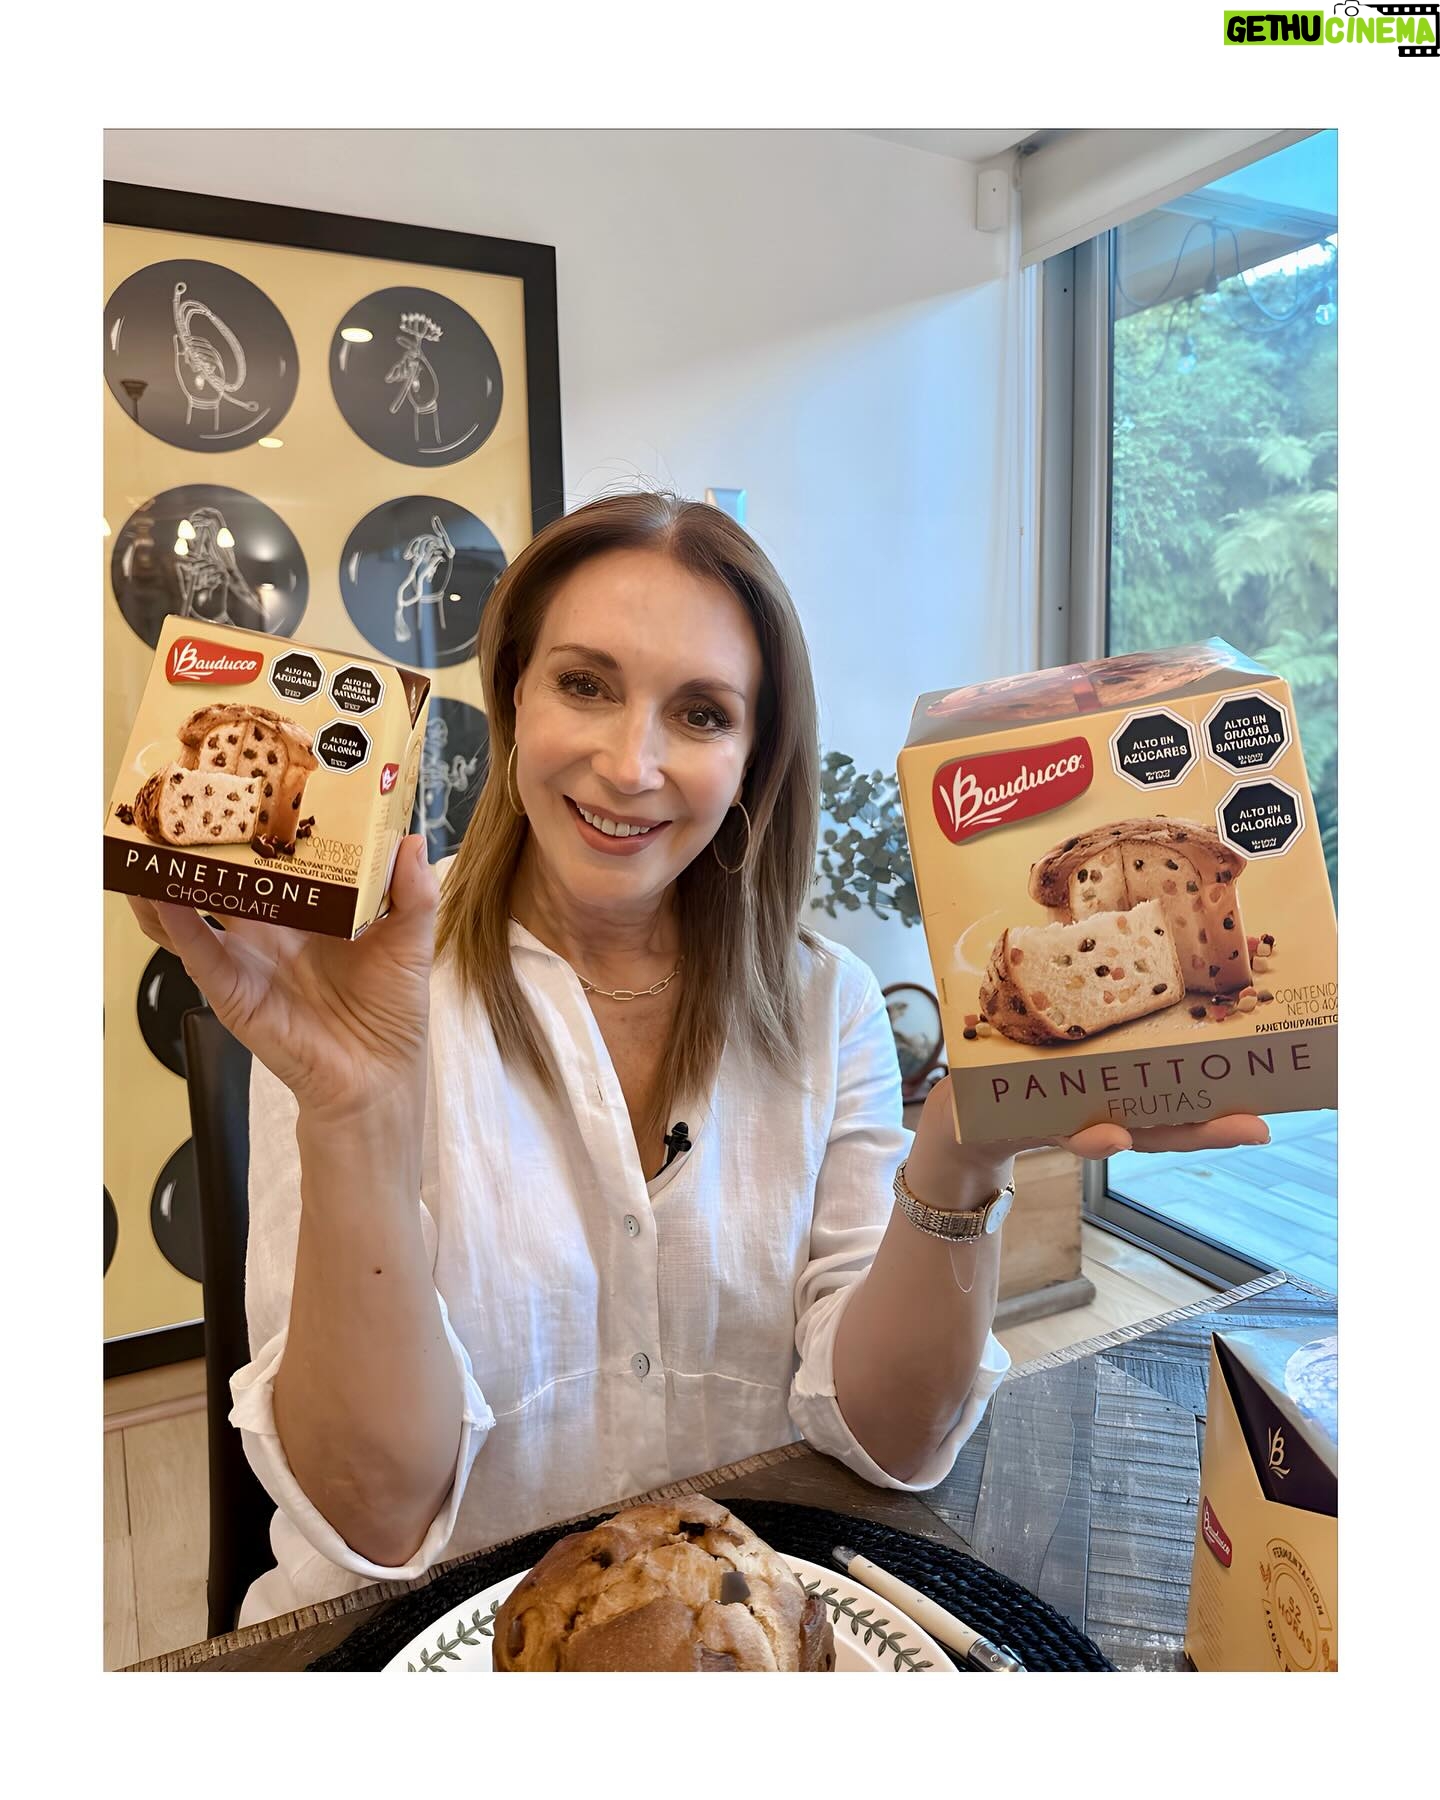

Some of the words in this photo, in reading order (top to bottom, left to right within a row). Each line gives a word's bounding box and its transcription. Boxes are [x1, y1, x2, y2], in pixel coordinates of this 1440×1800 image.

[173, 641, 257, 678] Bauducco
[284, 667, 302, 676] ALTO
[344, 677, 361, 686] ALTO
[1224, 718, 1250, 730] ALTO
[1252, 714, 1267, 725] EN
[330, 736, 347, 745] ALTO
[1132, 738, 1158, 750] ALTO
[1160, 735, 1174, 746] EN
[1215, 732, 1281, 753] SATURADAS
[1223, 724, 1270, 741] GRASAS
[1123, 745, 1188, 766] AZÚCARES
[938, 753, 1082, 832] Bauducco
[1239, 807, 1265, 819] ALTO
[1267, 804, 1281, 815] EN
[1231, 813, 1292, 833] CALORÍAS
[314, 849, 340, 863] NETO
[126, 849, 321, 907] PANETTONE
[166, 883, 280, 919] CHOCOLATE
[1275, 982, 1338, 1004] CONTENID
[1287, 1000, 1319, 1016] NETO
[991, 1043, 1312, 1103] PANETTONE
[1107, 1089, 1212, 1120] FRUTAS
[1278, 1597, 1312, 1655] HORAS
